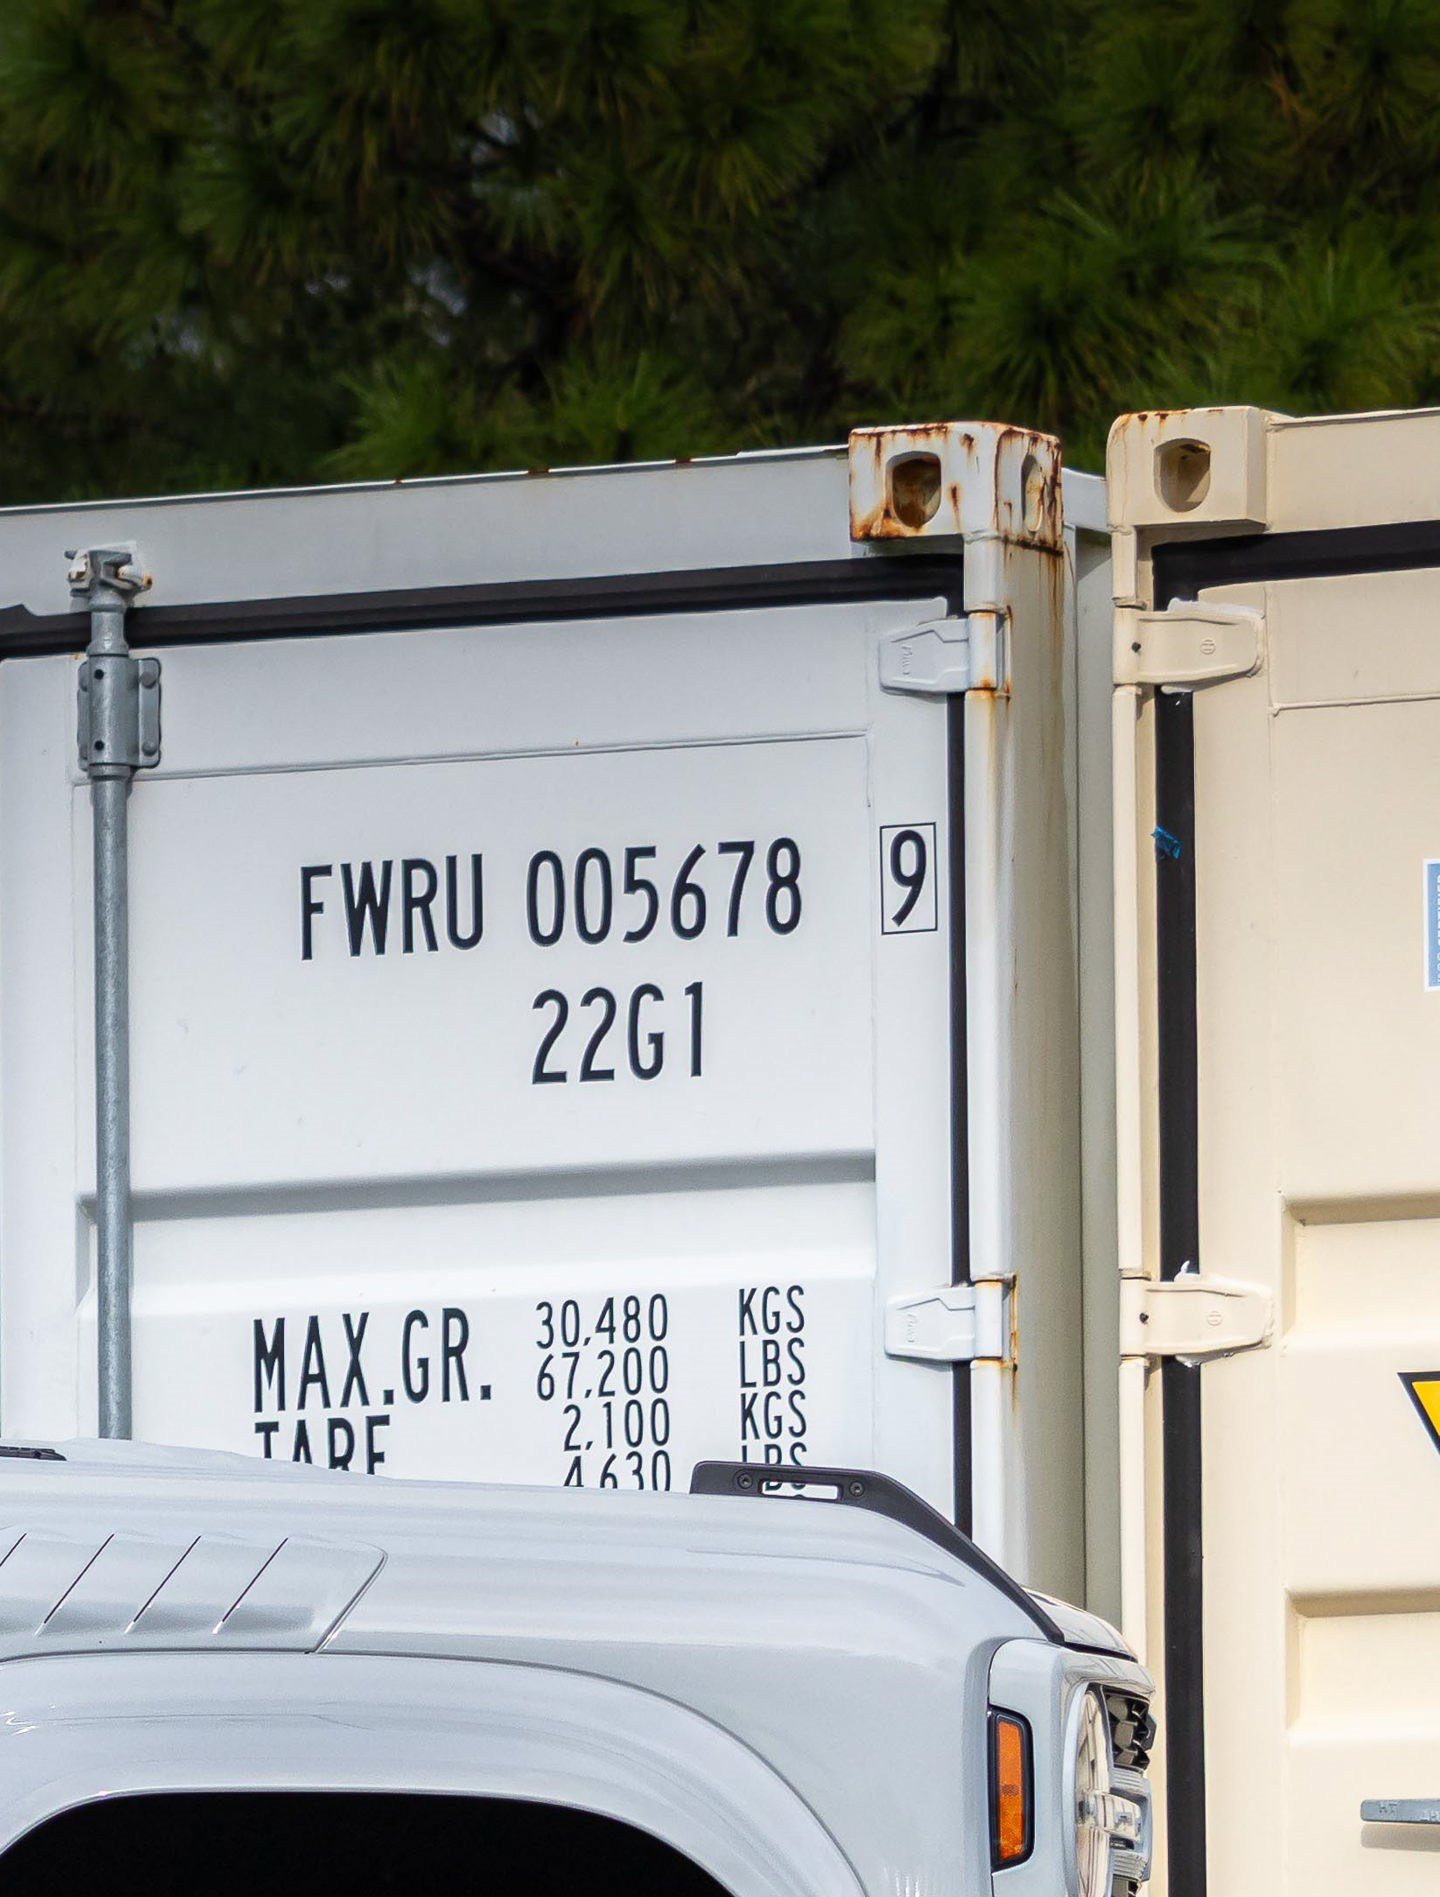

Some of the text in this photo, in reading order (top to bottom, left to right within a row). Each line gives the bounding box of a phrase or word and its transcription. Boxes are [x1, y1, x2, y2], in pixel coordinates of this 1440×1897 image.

[300, 829, 927, 961] FWRU 005678 9
[532, 981, 703, 1085] 22G1
[253, 1285, 805, 1413] MAX.GR. 30,480 KGS
[537, 1338, 806, 1402] 67,200 LBS
[563, 1399, 670, 1452] 2,100
[740, 1390, 807, 1441] KGS
